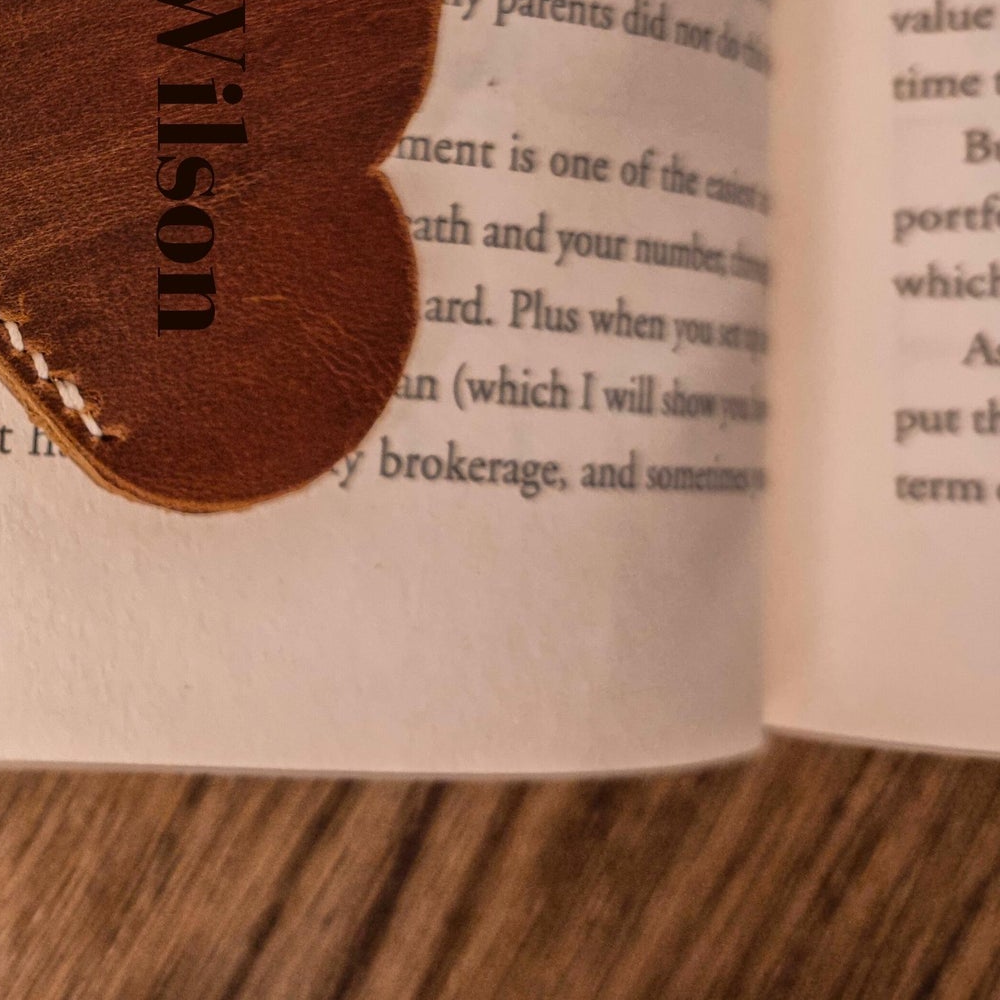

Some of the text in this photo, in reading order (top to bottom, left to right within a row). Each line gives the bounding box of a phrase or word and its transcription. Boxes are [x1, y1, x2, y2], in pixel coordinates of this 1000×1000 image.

[673, 20, 714, 53] not
[890, 62, 982, 102] time
[396, 130, 495, 170] ment
[508, 132, 536, 174] is
[549, 151, 611, 183] one
[619, 147, 655, 189] of
[660, 152, 700, 196] the
[406, 202, 472, 247] ath
[482, 209, 548, 255] and
[553, 223, 628, 267] your
[424, 284, 494, 326] ard.
[508, 287, 579, 334] Plus
[589, 296, 666, 343] when
[672, 317, 714, 354] you
[396, 371, 438, 402] an
[453, 361, 571, 413] (which
[581, 371, 596, 412] I
[602, 373, 655, 416] will
[893, 402, 961, 444] put
[378, 436, 568, 500] brokerage,
[580, 448, 638, 491] and
[894, 472, 984, 505] term
